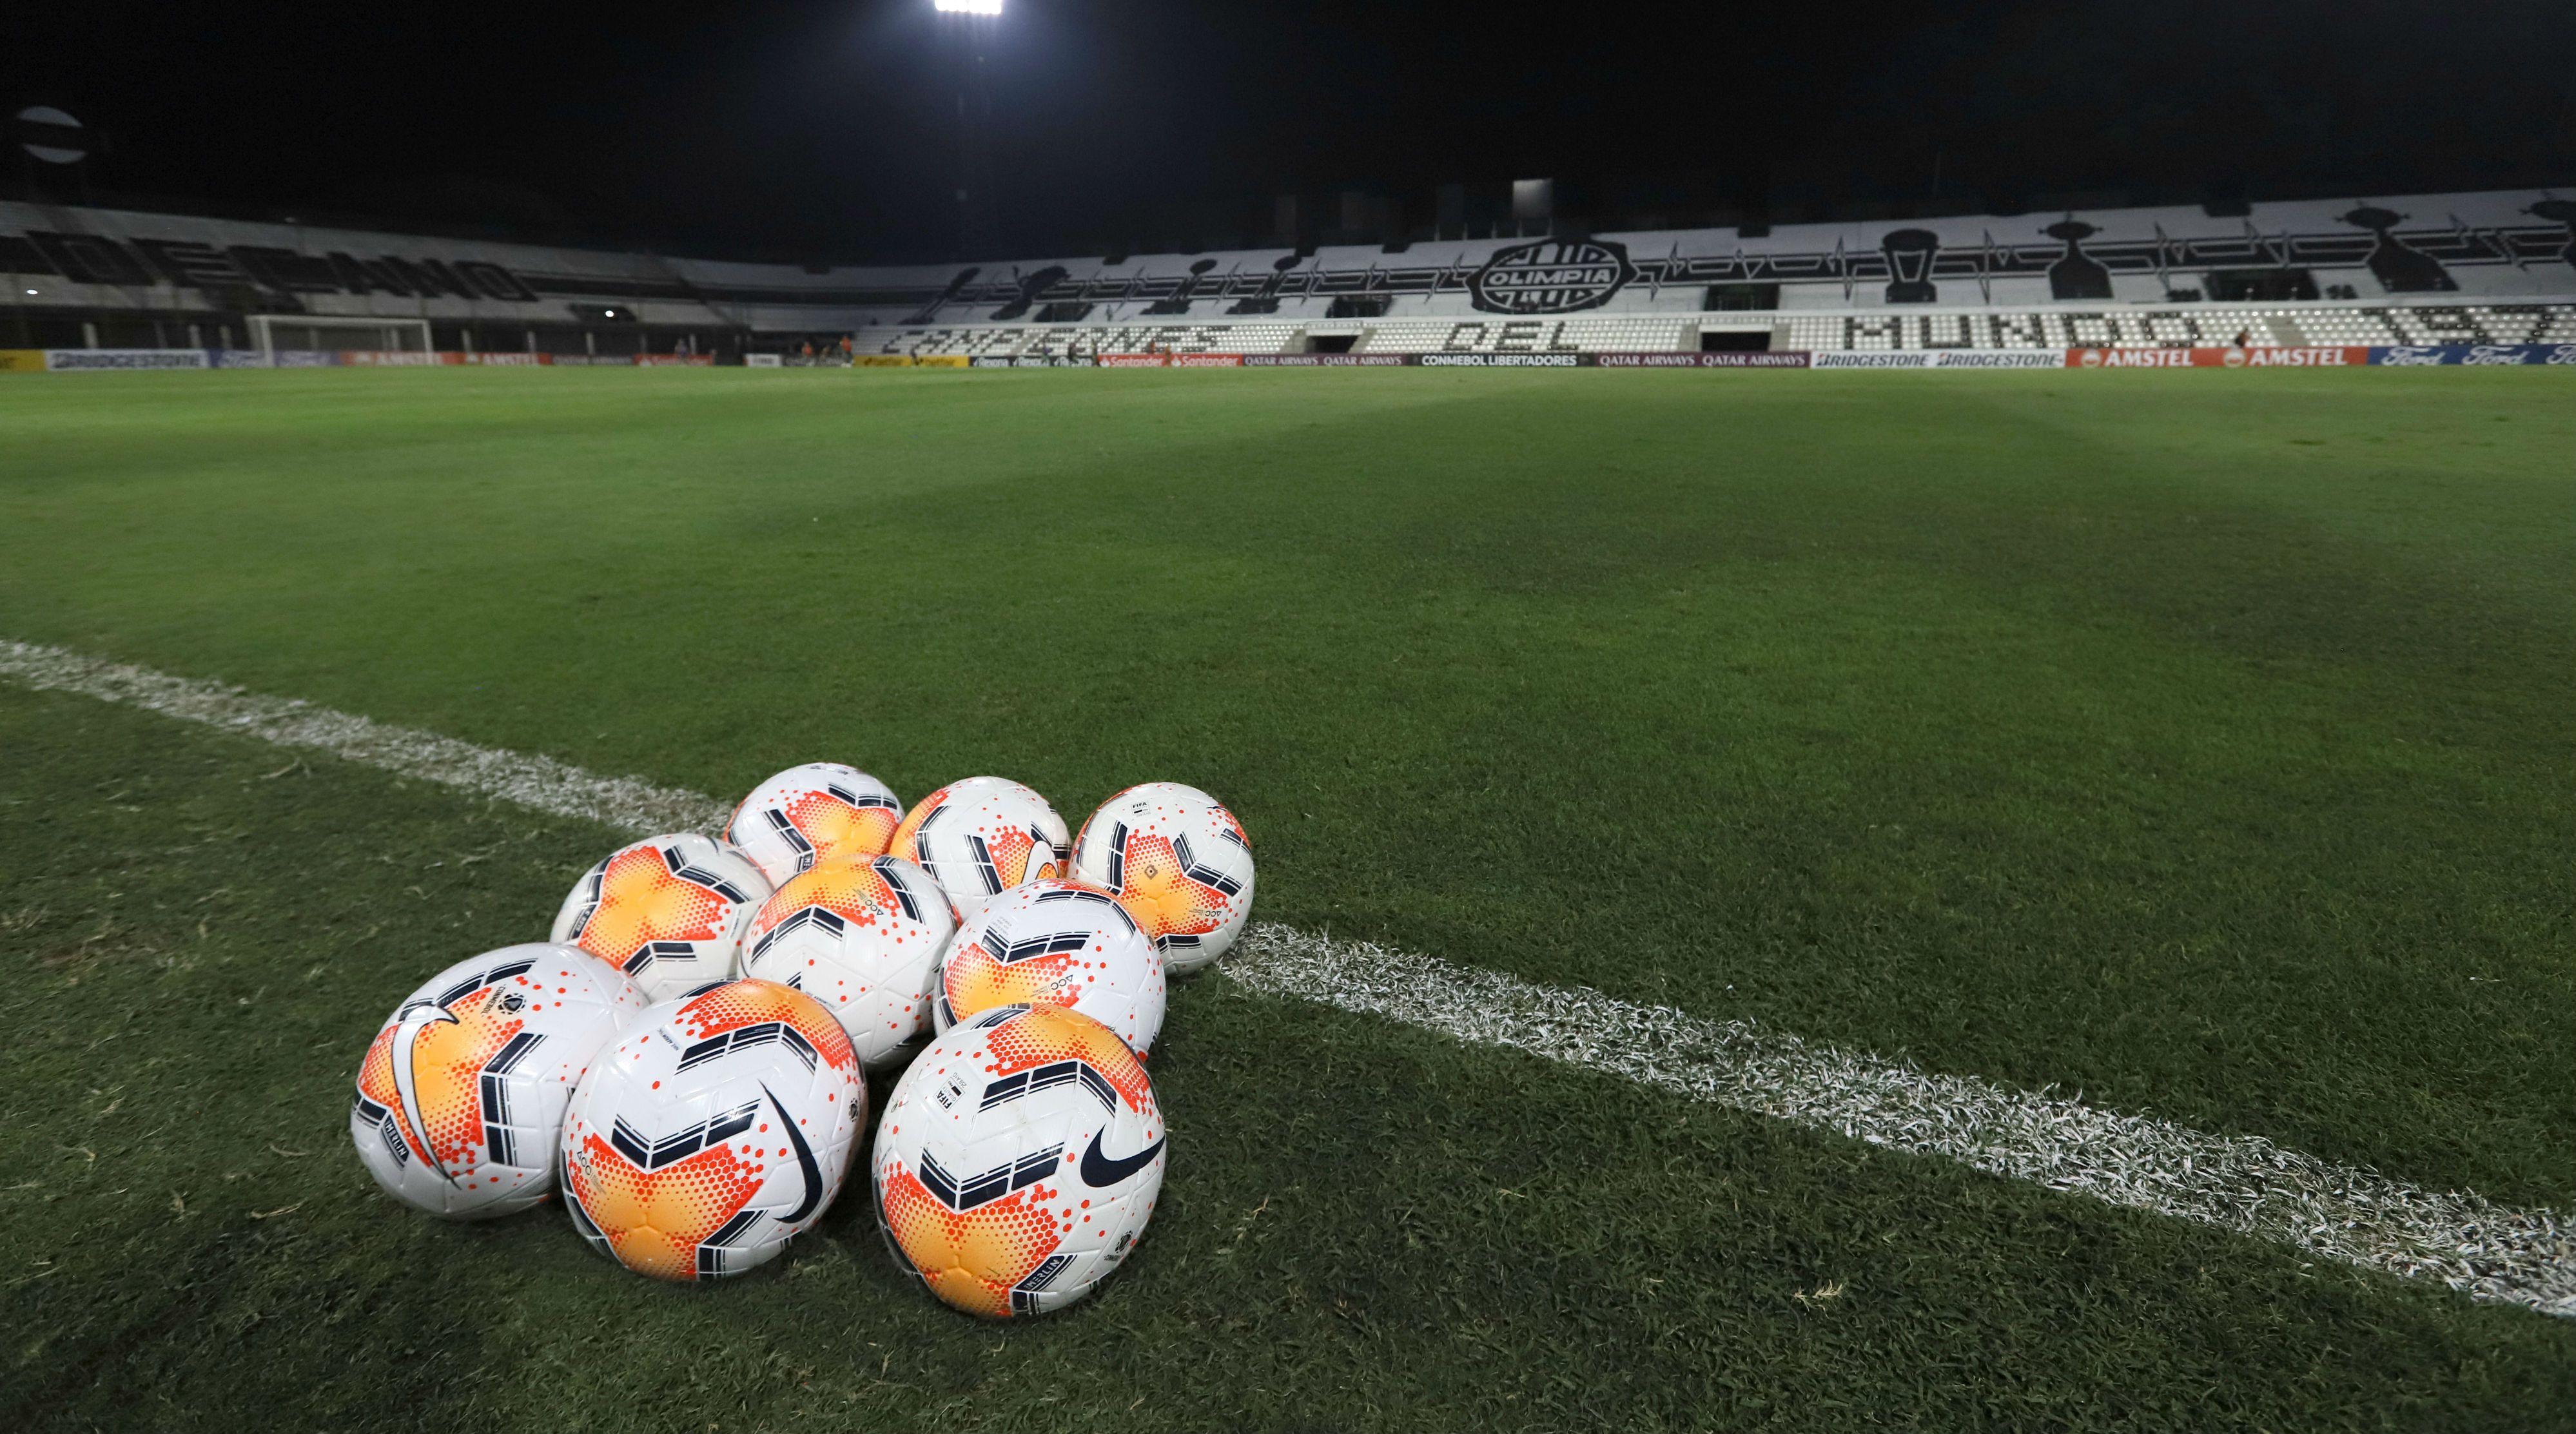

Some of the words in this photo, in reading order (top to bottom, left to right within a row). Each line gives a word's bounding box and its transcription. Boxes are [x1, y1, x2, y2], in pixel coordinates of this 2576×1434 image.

[1488, 267, 1612, 286] OLIMPIA
[1443, 321, 1579, 351] DEL
[1844, 312, 2201, 350] MUNDO
[2362, 305, 2576, 345] 197
[979, 357, 1009, 367] Rexona
[1110, 356, 1164, 366] Santander
[1182, 355, 1238, 366] Santander
[1244, 356, 1276, 365] QATAR
[1278, 356, 1318, 365] AIRWAYS
[1323, 356, 1357, 365] QATAR
[1360, 356, 1402, 365] AIRWAYS
[1422, 356, 1487, 365] CONMEBOL
[1488, 356, 1577, 365] LIBERTADORES
[1599, 355, 1640, 367] QATAR
[1643, 355, 1695, 365] AIRWAYS
[1702, 354, 1746, 367] QATAR
[1750, 354, 1805, 365] AIRWAYS
[1816, 353, 1930, 367] BRIDGESTONE
[1937, 353, 2063, 367] BRIDGESTONE
[2104, 349, 2194, 367] AMSTEL
[2249, 349, 2348, 366] AMSTEL
[2381, 345, 2446, 365] Ford
[2461, 345, 2530, 365] Ford
[2546, 345, 2576, 365] Fo
[481, 984, 507, 1015] CONMEBOL
[937, 1090, 952, 1109] FIFA
[942, 1086, 957, 1102] QUALITY
[385, 1121, 406, 1156] MERLIN
[1024, 1257, 1061, 1288] MERLIN
